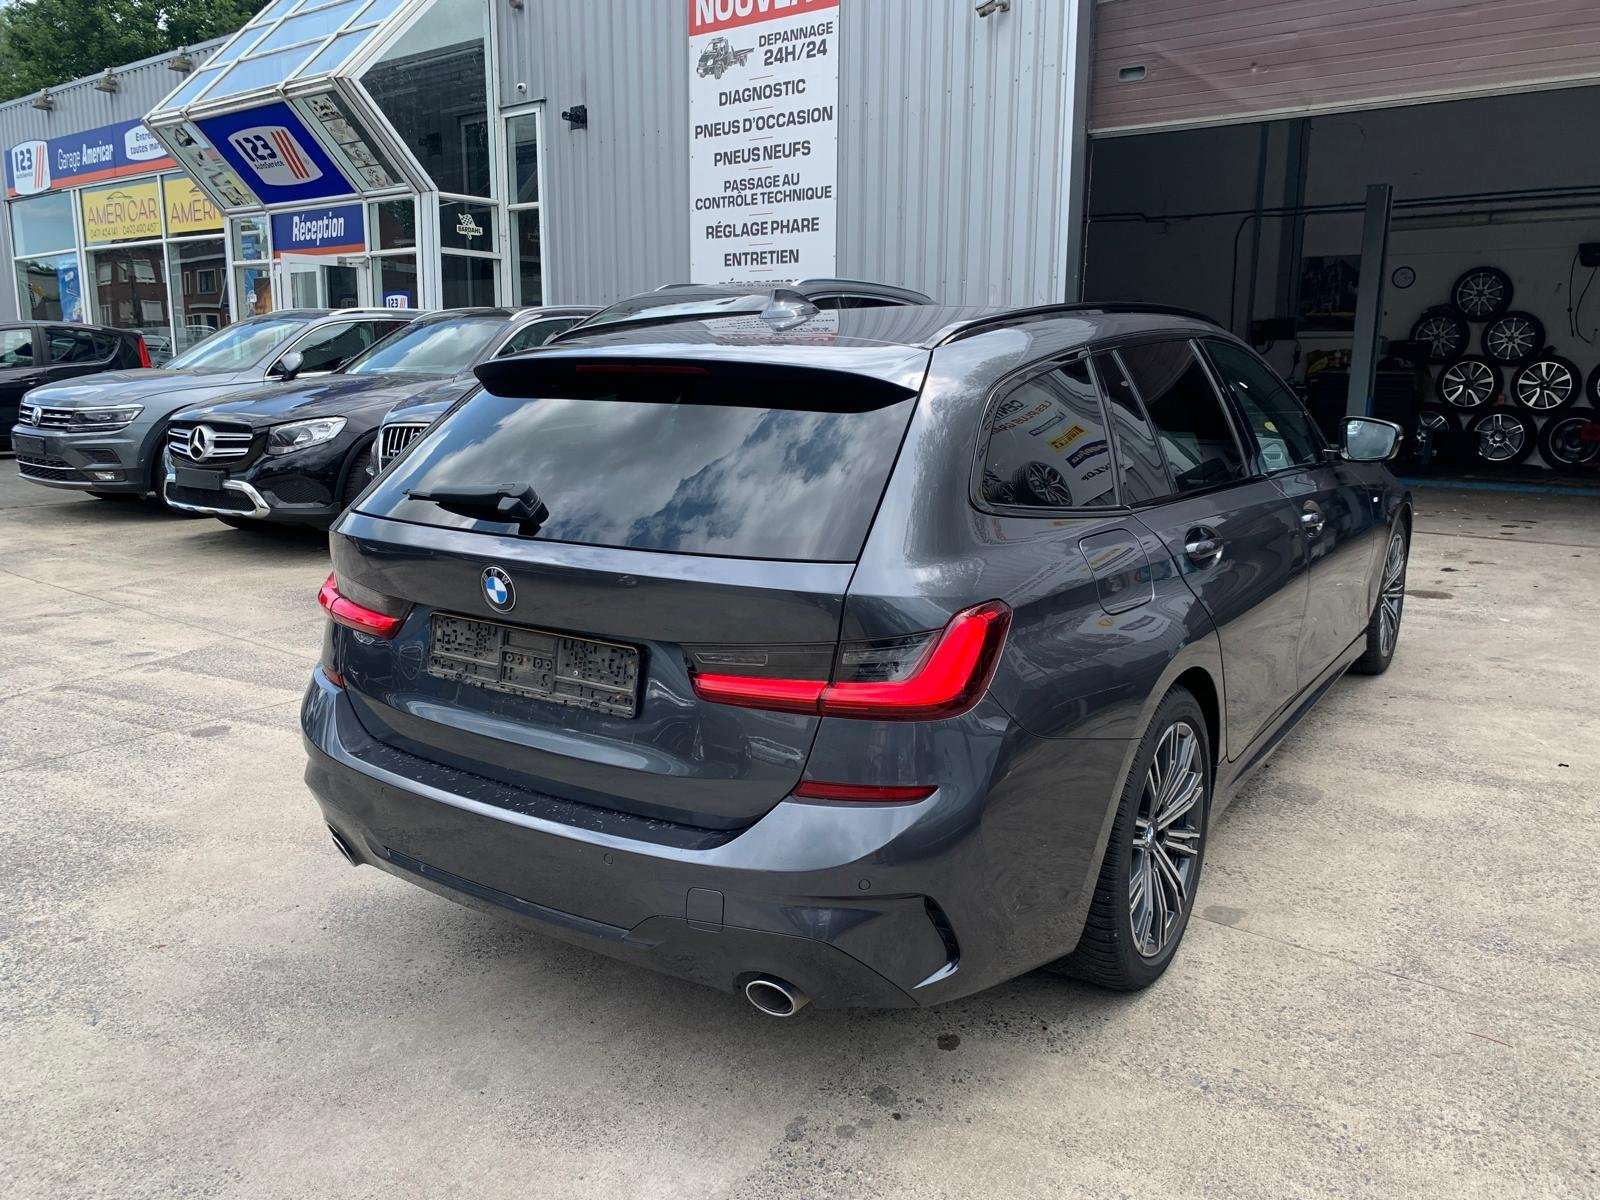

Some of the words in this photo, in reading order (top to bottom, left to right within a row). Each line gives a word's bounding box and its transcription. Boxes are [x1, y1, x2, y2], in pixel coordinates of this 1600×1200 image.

[758, 21, 834, 48] DEPANNAGE
[763, 38, 828, 67] 24H/24
[718, 78, 807, 107] DIAGNOSTIC
[694, 119, 740, 140] PNEUS
[742, 105, 834, 133] D'OCCASION
[15, 148, 32, 172] 123
[58, 149, 81, 173] Garage
[235, 135, 277, 163] 123
[714, 146, 761, 167] PNEUS
[762, 140, 811, 161] NEUFS
[724, 174, 780, 193] PASSAGE
[781, 173, 800, 187] AU
[171, 198, 215, 224] AMERI
[695, 190, 758, 211] CONTRÔLE
[759, 185, 832, 205] TECHNIQUE
[292, 211, 345, 245] Réception
[705, 220, 768, 239] RÉGLAGE
[770, 217, 820, 235] PHARE
[724, 249, 800, 267] ENTRETIEN
